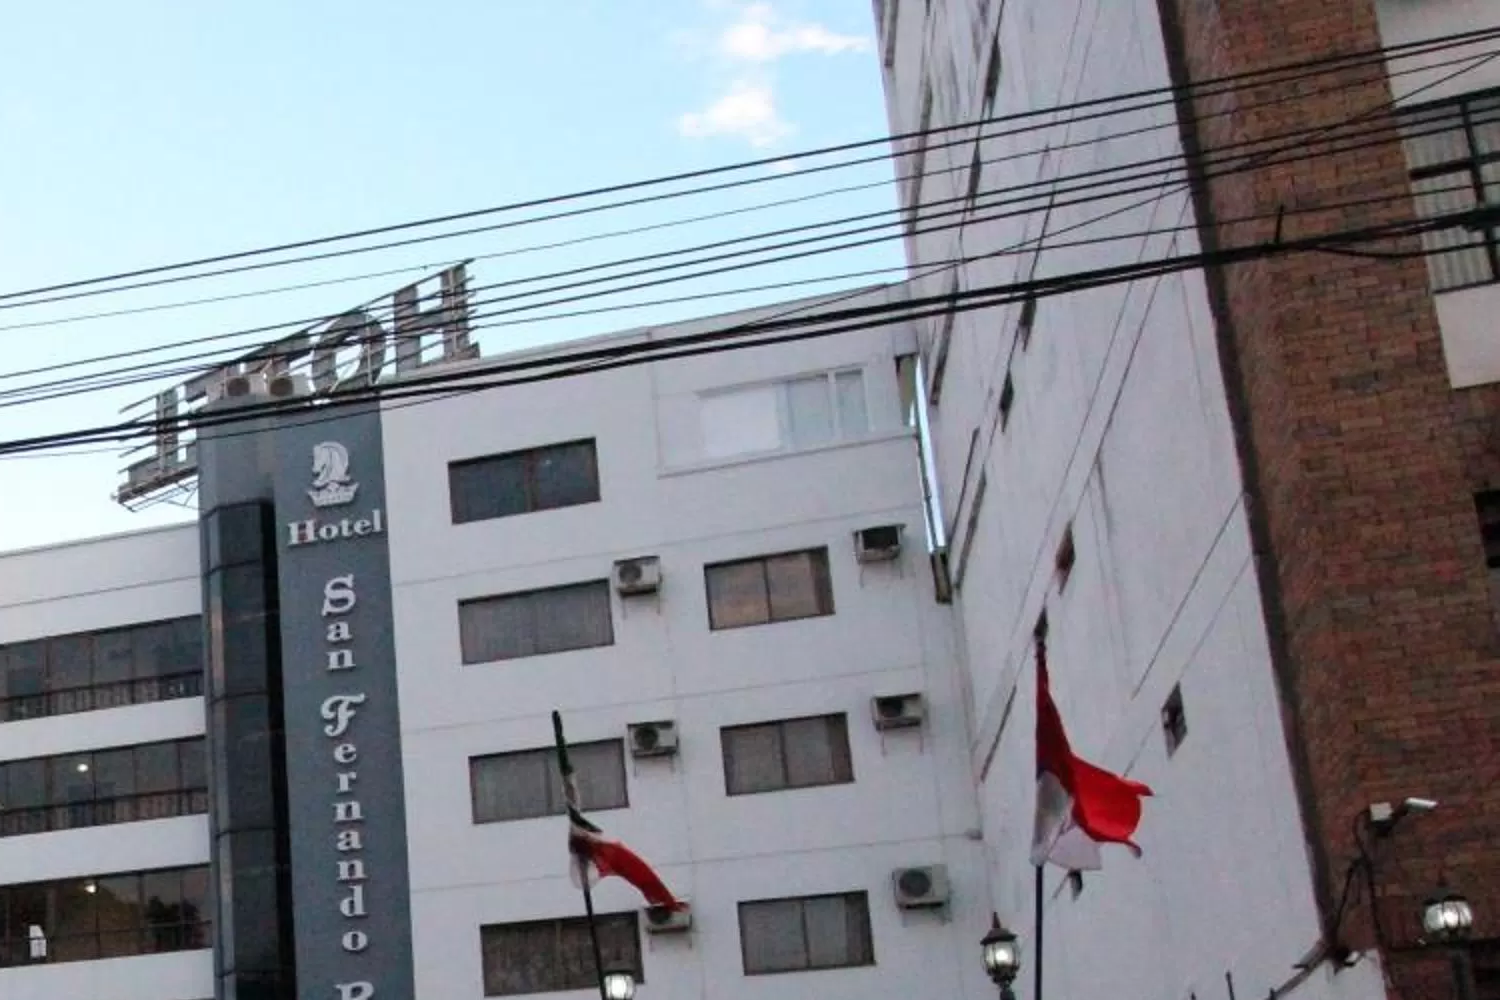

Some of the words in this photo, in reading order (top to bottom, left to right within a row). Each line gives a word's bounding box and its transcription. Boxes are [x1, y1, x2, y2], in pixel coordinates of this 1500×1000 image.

[288, 509, 384, 546] Hotel
[321, 573, 358, 672] San
[320, 693, 368, 953] Fernando
